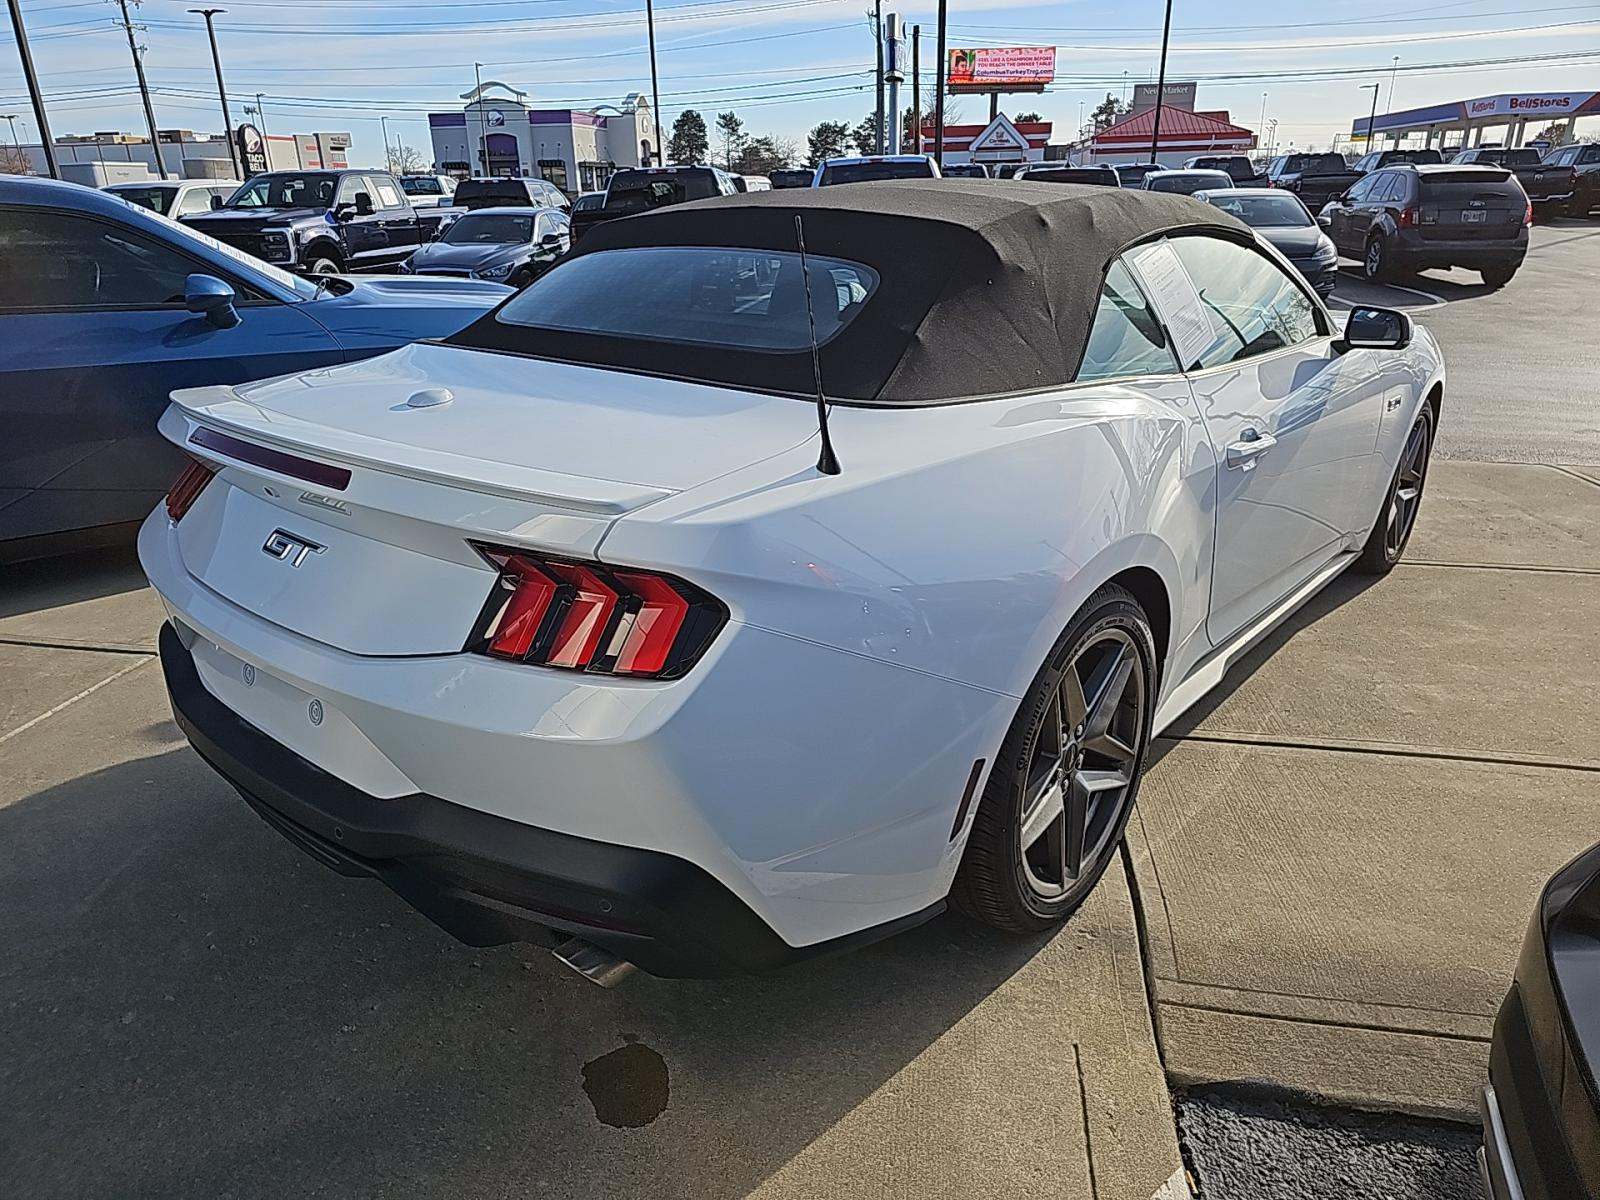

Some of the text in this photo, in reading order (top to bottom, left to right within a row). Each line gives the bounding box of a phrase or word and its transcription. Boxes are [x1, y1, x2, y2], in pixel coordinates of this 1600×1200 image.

[976, 68, 1053, 76] ColumbusTurkeyTrot.com
[1162, 85, 1189, 95] Market
[245, 153, 265, 163] TACO
[249, 162, 266, 172] BELL
[262, 526, 328, 569] GT
